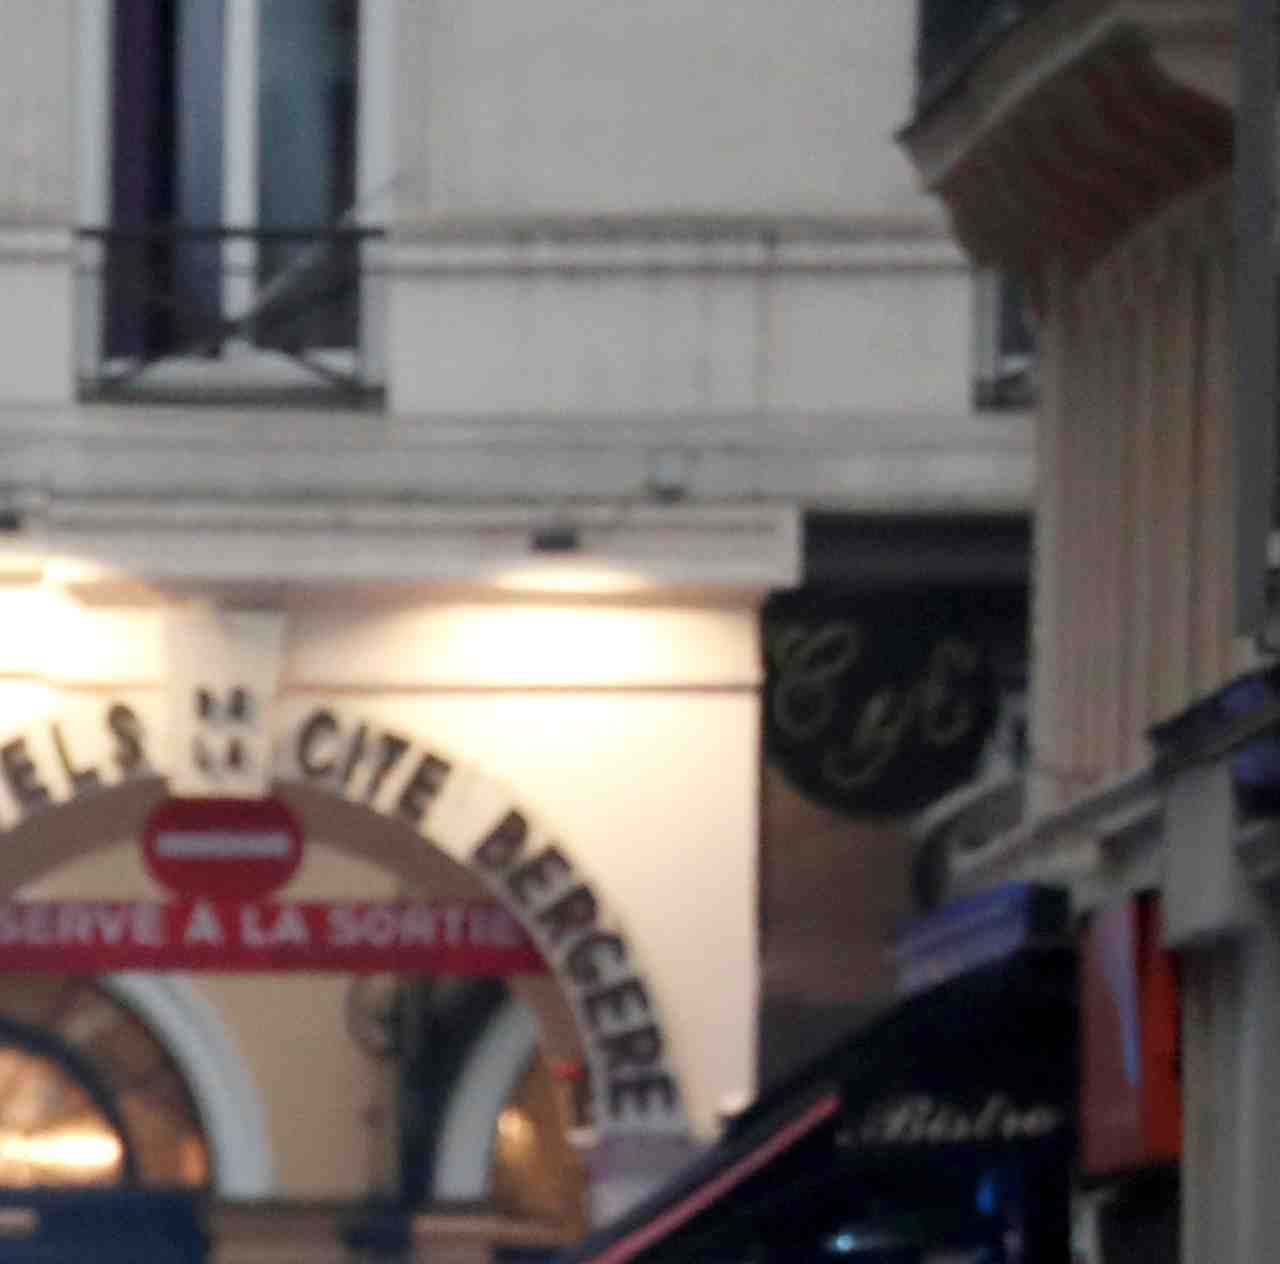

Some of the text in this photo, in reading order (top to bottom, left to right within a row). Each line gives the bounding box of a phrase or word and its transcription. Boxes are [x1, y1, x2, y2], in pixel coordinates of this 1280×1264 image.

[241, 902, 308, 944] LA
[329, 903, 524, 944] SORTIE
[475, 808, 682, 1116] BERGERE
